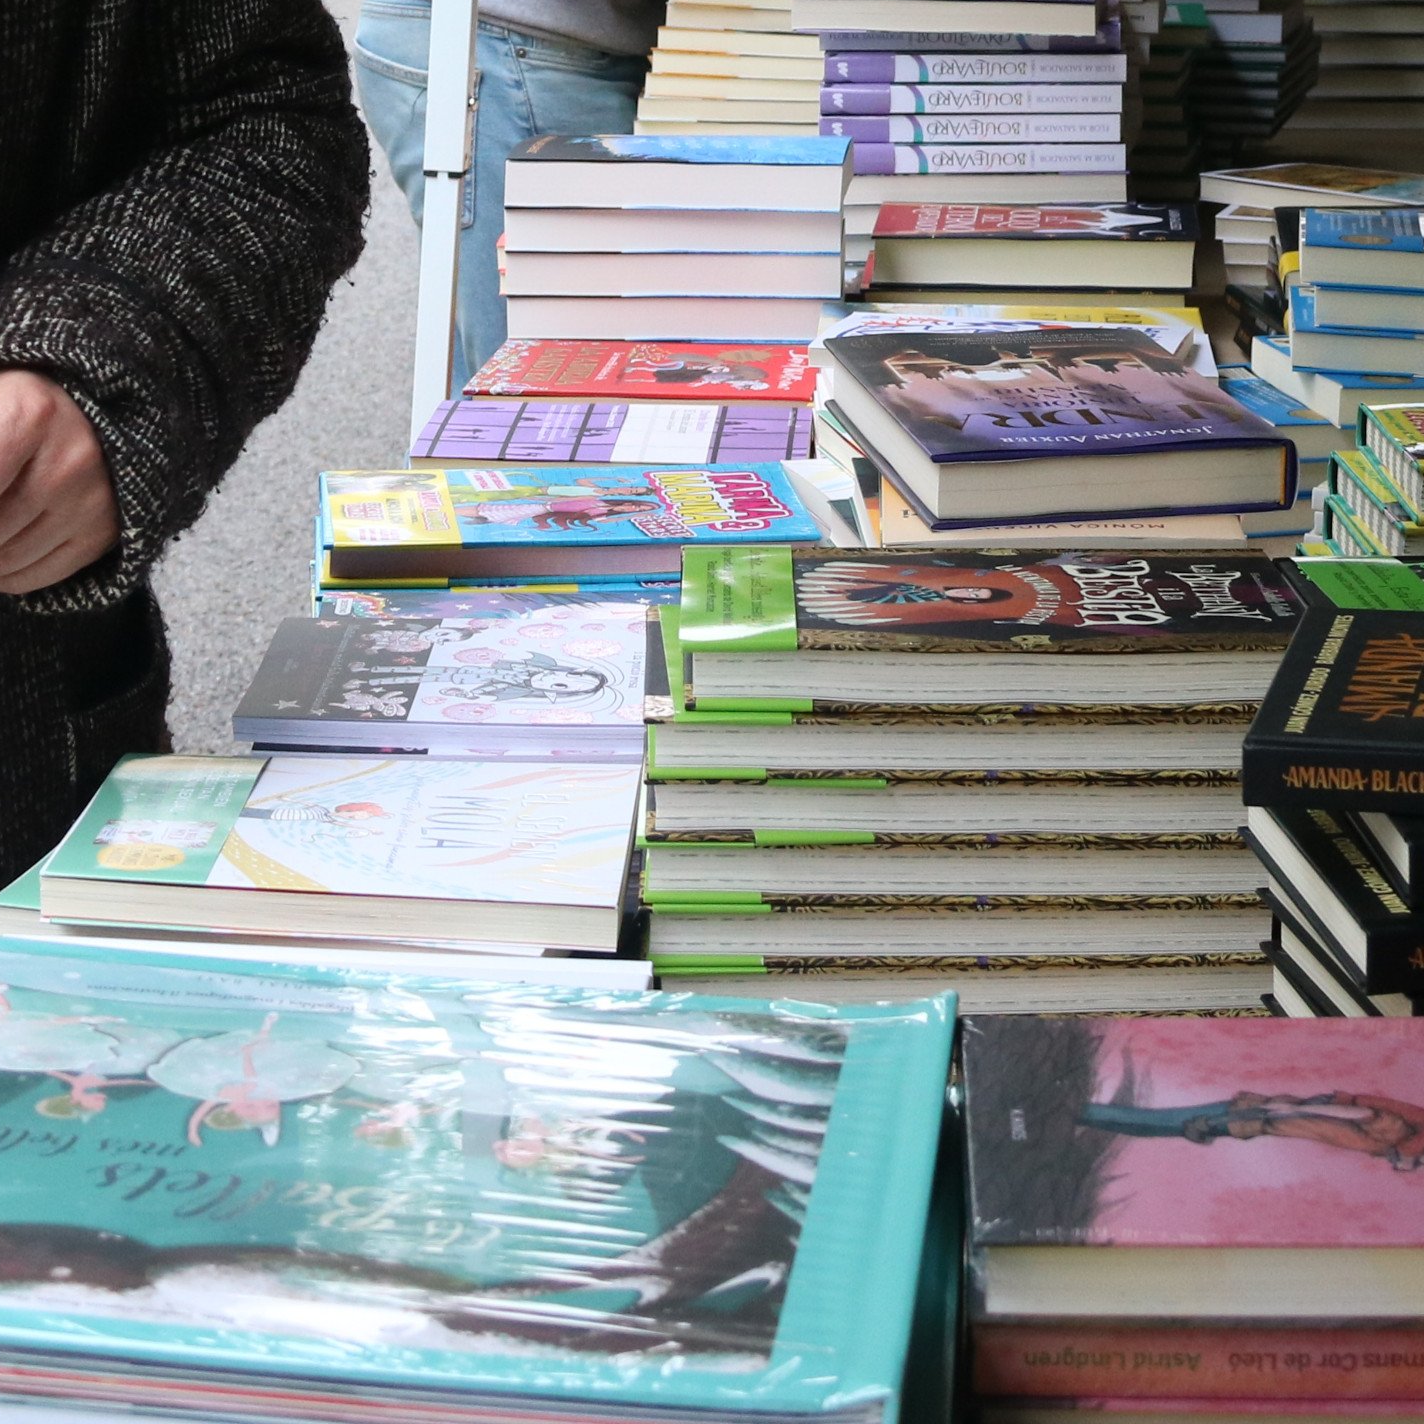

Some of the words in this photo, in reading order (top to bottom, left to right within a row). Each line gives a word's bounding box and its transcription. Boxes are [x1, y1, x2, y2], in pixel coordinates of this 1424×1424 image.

[932, 58, 1027, 78] BOULEVARD
[928, 89, 1022, 109] BOULEVARD
[926, 118, 1020, 139] BOULEVARD
[932, 148, 1026, 169] BOULEVARD
[999, 433, 1087, 444] AUXIER
[1093, 425, 1215, 443] JONATHAN
[654, 472, 732, 525] MARINA
[707, 473, 787, 521] KARINA
[1165, 570, 1273, 623] BETHANY
[1326, 614, 1355, 638] MONTES
[1313, 638, 1346, 665] BÁRBARA
[1283, 715, 1311, 734] JUAN
[1282, 766, 1370, 791] AMANDA
[523, 791, 571, 807] EL
[420, 794, 510, 850] MOLA
[507, 814, 568, 862] SEMEN
[95, 1135, 187, 1163] més
[85, 1164, 410, 1233] Ballets
[1023, 1350, 1122, 1372] Lindgren
[1125, 1350, 1201, 1370] Astrid
[1227, 1351, 1278, 1371] Lleó
[1284, 1351, 1312, 1370] de
[1315, 1351, 1359, 1370] Cor
